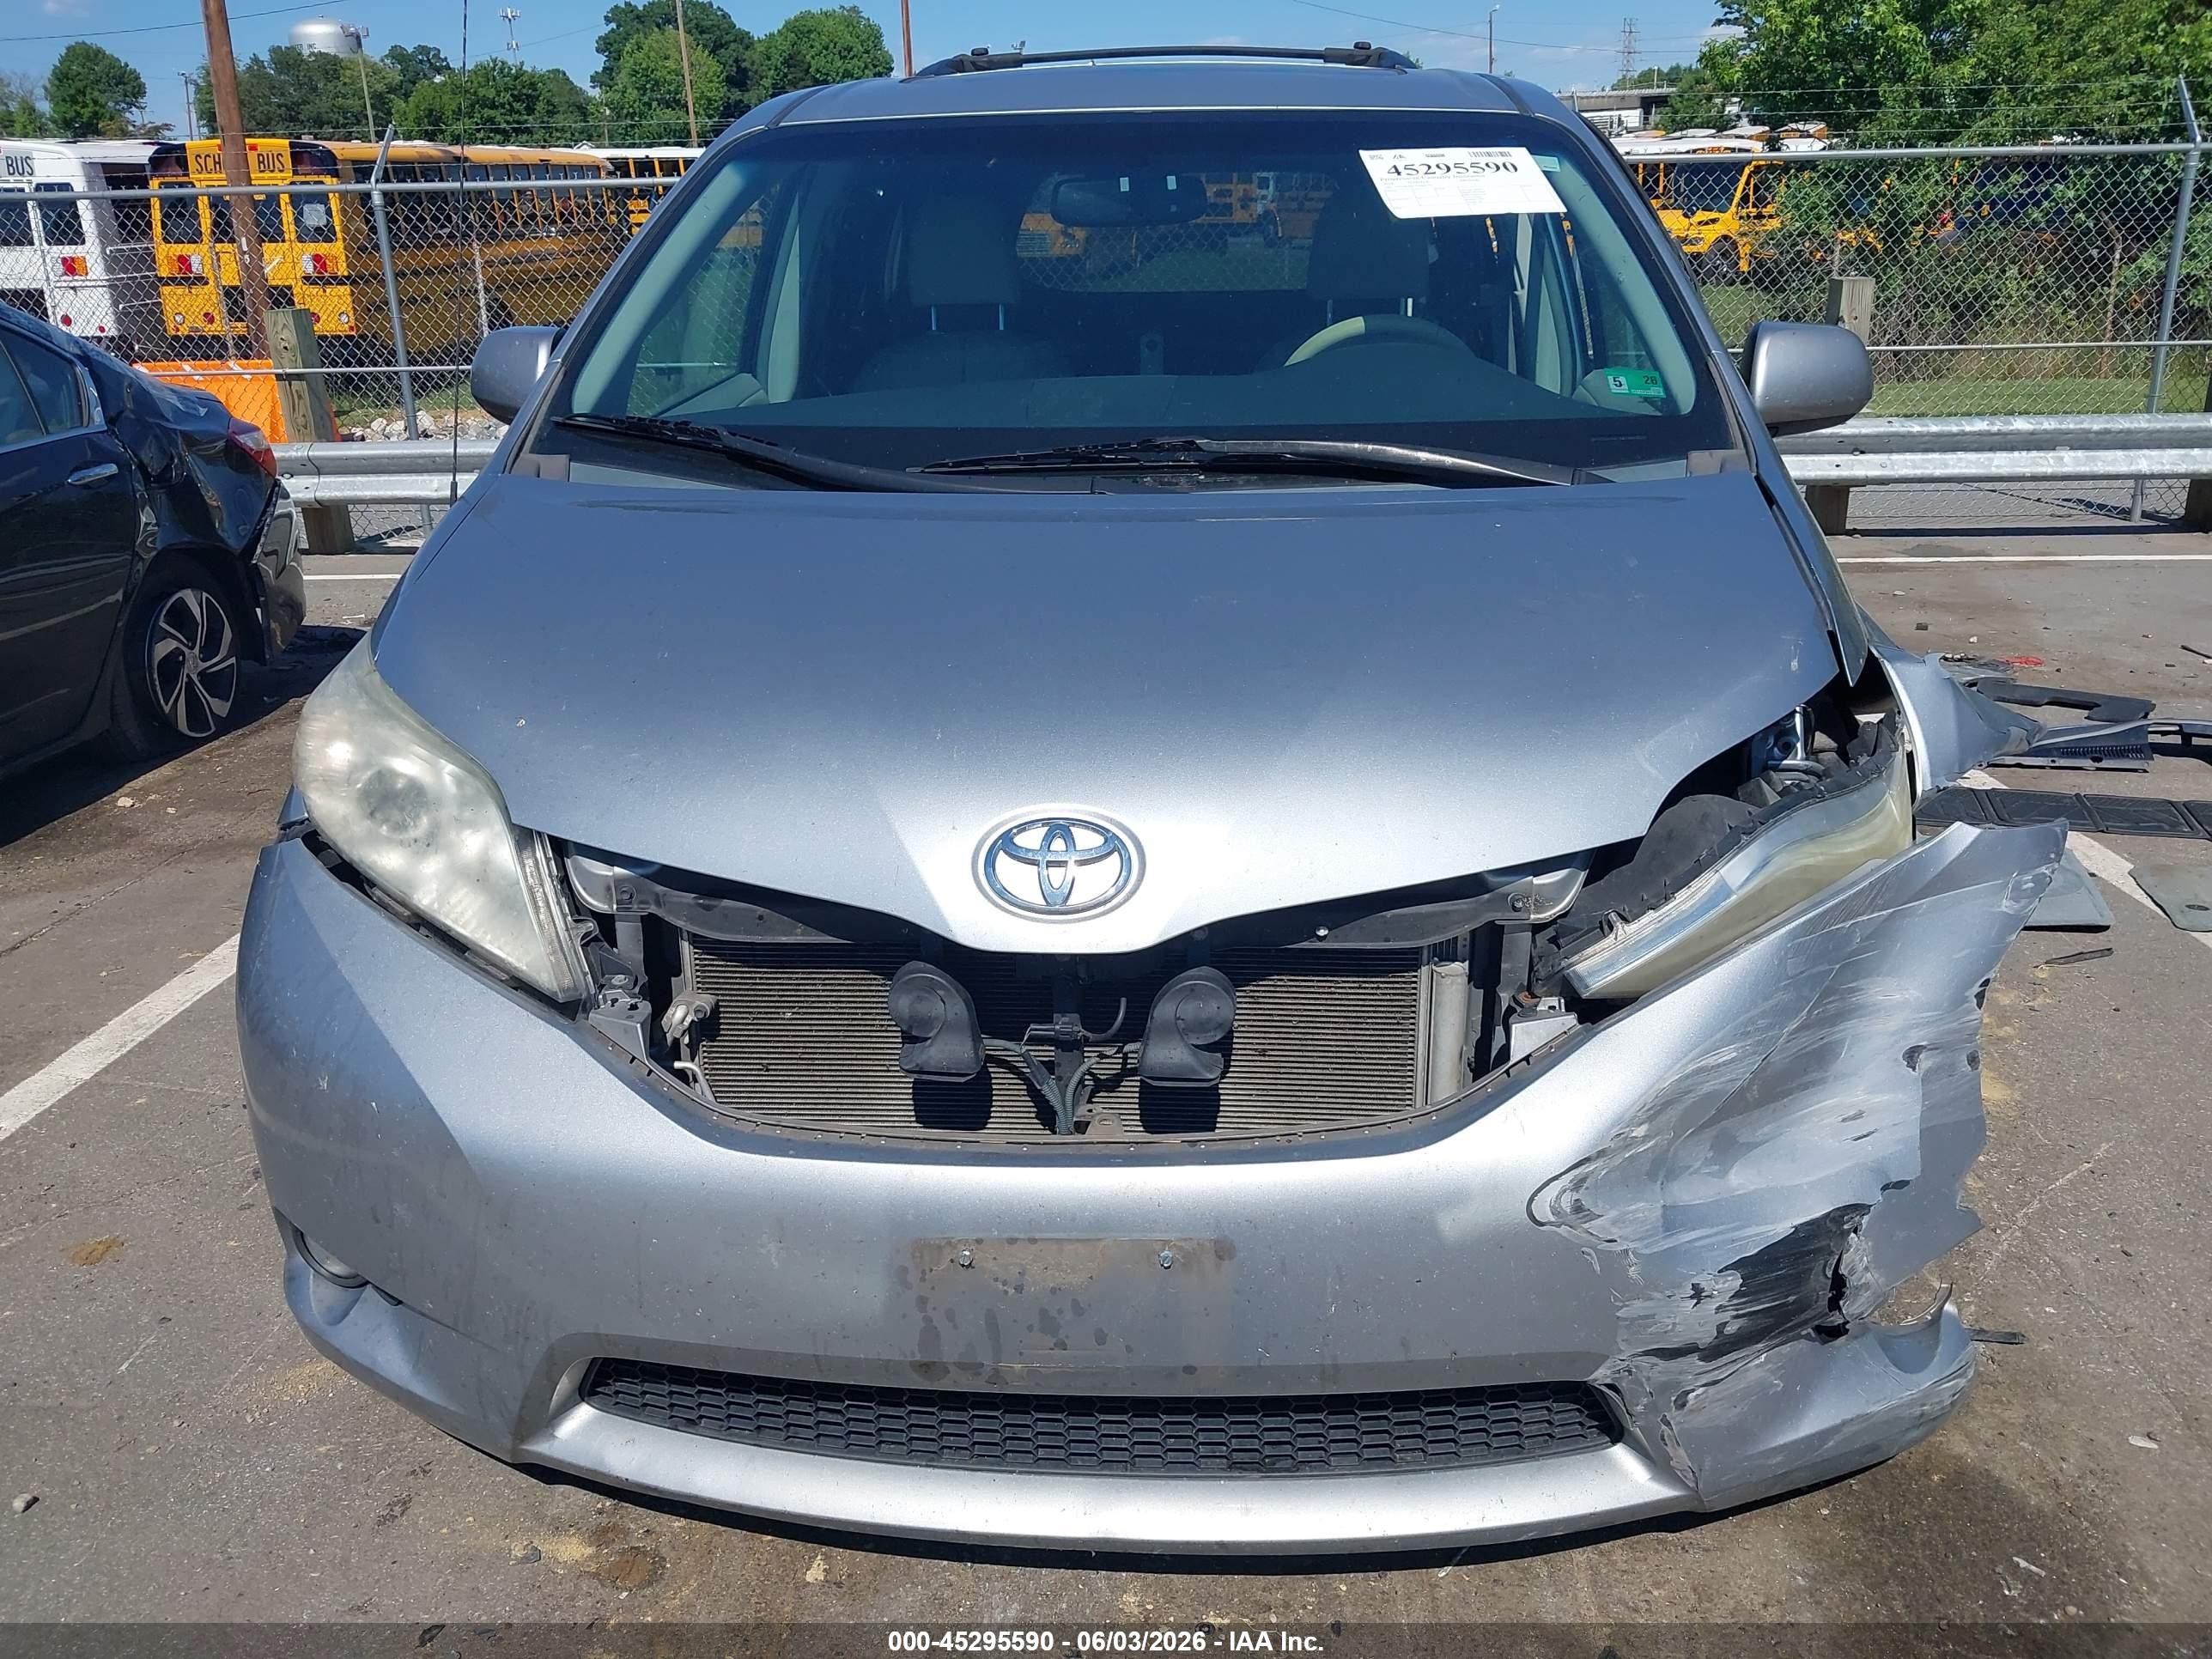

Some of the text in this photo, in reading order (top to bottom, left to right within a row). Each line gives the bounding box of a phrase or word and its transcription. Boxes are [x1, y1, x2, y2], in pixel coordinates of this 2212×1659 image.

[5, 155, 33, 176] BUS
[195, 153, 285, 173] SCH BUS
[1388, 161, 1518, 176] 45295590
[1613, 376, 1623, 387] 5
